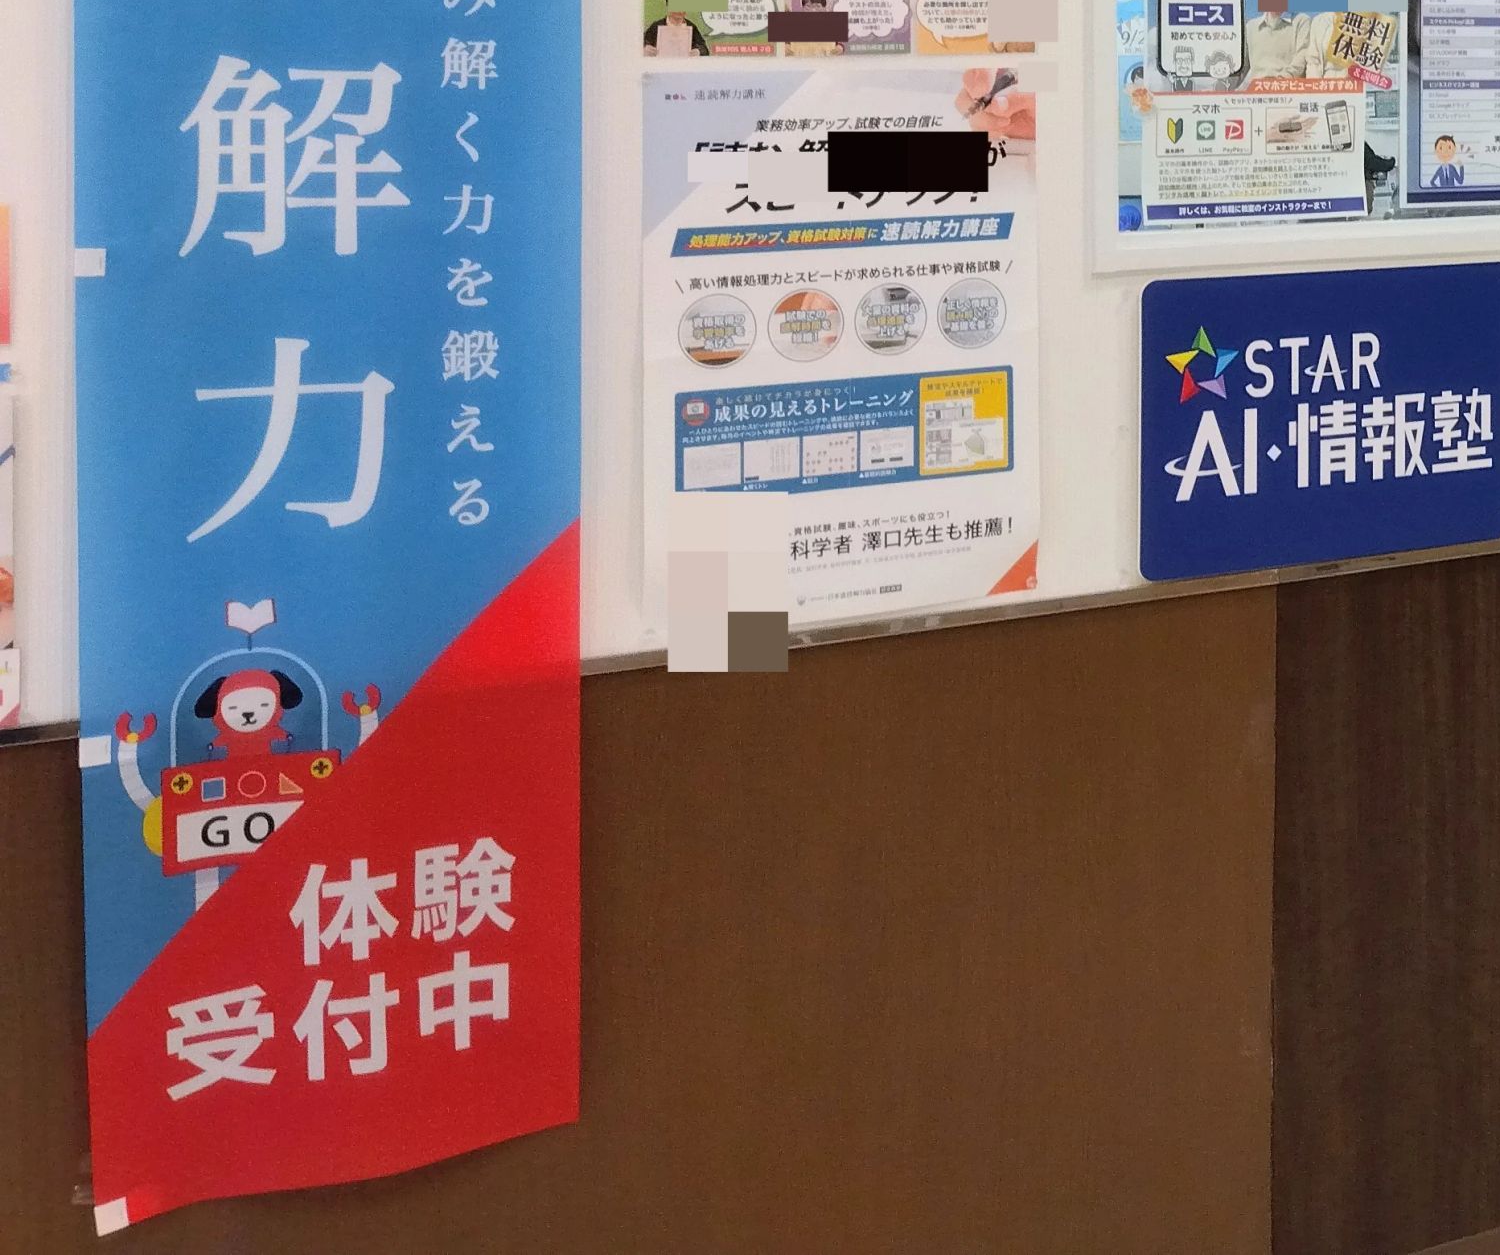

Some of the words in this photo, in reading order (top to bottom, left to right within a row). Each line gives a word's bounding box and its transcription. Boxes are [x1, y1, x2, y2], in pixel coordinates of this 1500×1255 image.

[1178, 5, 1225, 23] コース
[1342, 12, 1391, 46] 無料
[1332, 34, 1386, 72] 体験
[1254, 78, 1358, 92] スマホデビューにおすすめ！
[755, 115, 943, 132] 業務効率アップ、試験での自信に
[1192, 104, 1221, 114] スマホ
[1299, 103, 1319, 113] 脳活
[880, 217, 1000, 243] 速読解力講座
[689, 260, 1001, 291] 高い情報処理力とスピードが求められる仕事や資格試験
[1244, 332, 1381, 398] STAR
[713, 389, 914, 424] 成果の見えるトレーニング
[790, 533, 854, 560] 科学者
[201, 811, 275, 848] GO
[289, 837, 516, 967] 体験
[166, 950, 509, 1101] 受付中
